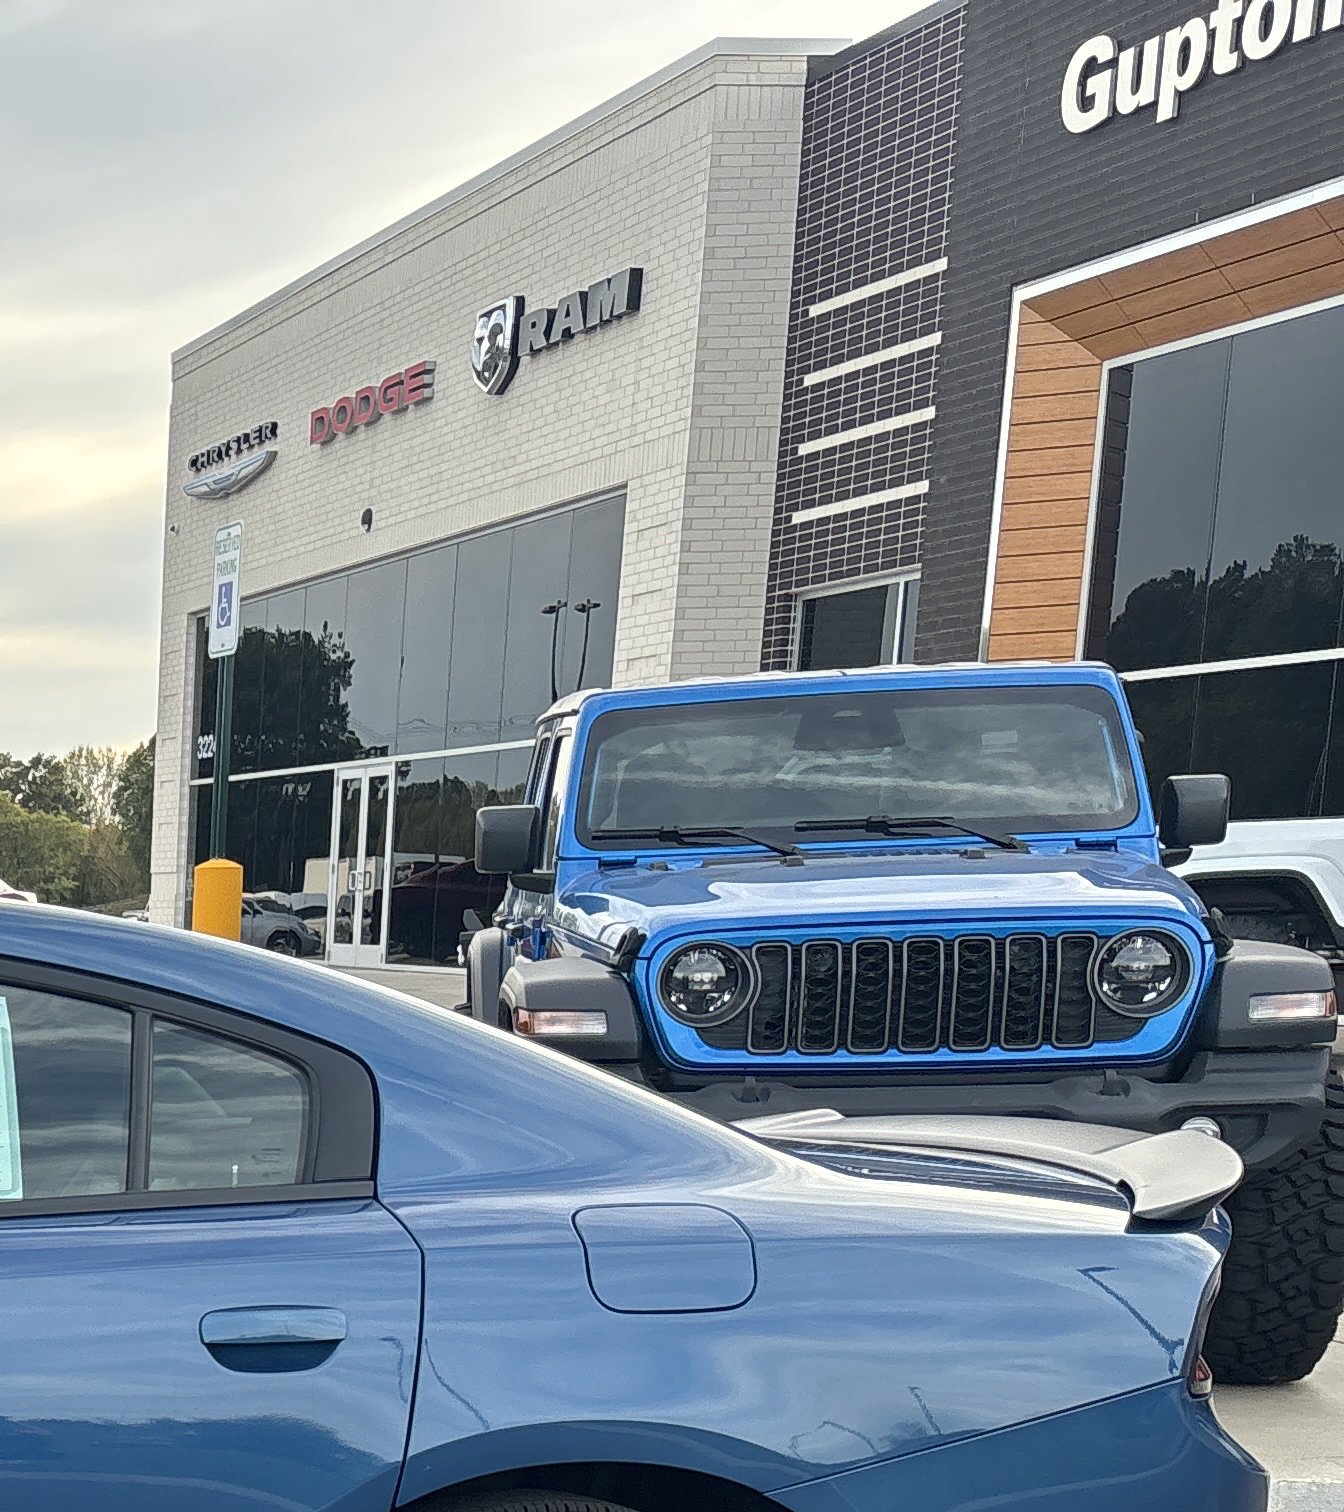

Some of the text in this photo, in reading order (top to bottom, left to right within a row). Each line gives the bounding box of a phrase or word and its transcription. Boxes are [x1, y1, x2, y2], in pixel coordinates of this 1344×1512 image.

[517, 267, 643, 357] RAM
[310, 360, 436, 446] DODGE
[188, 421, 278, 472] CHRYSLER
